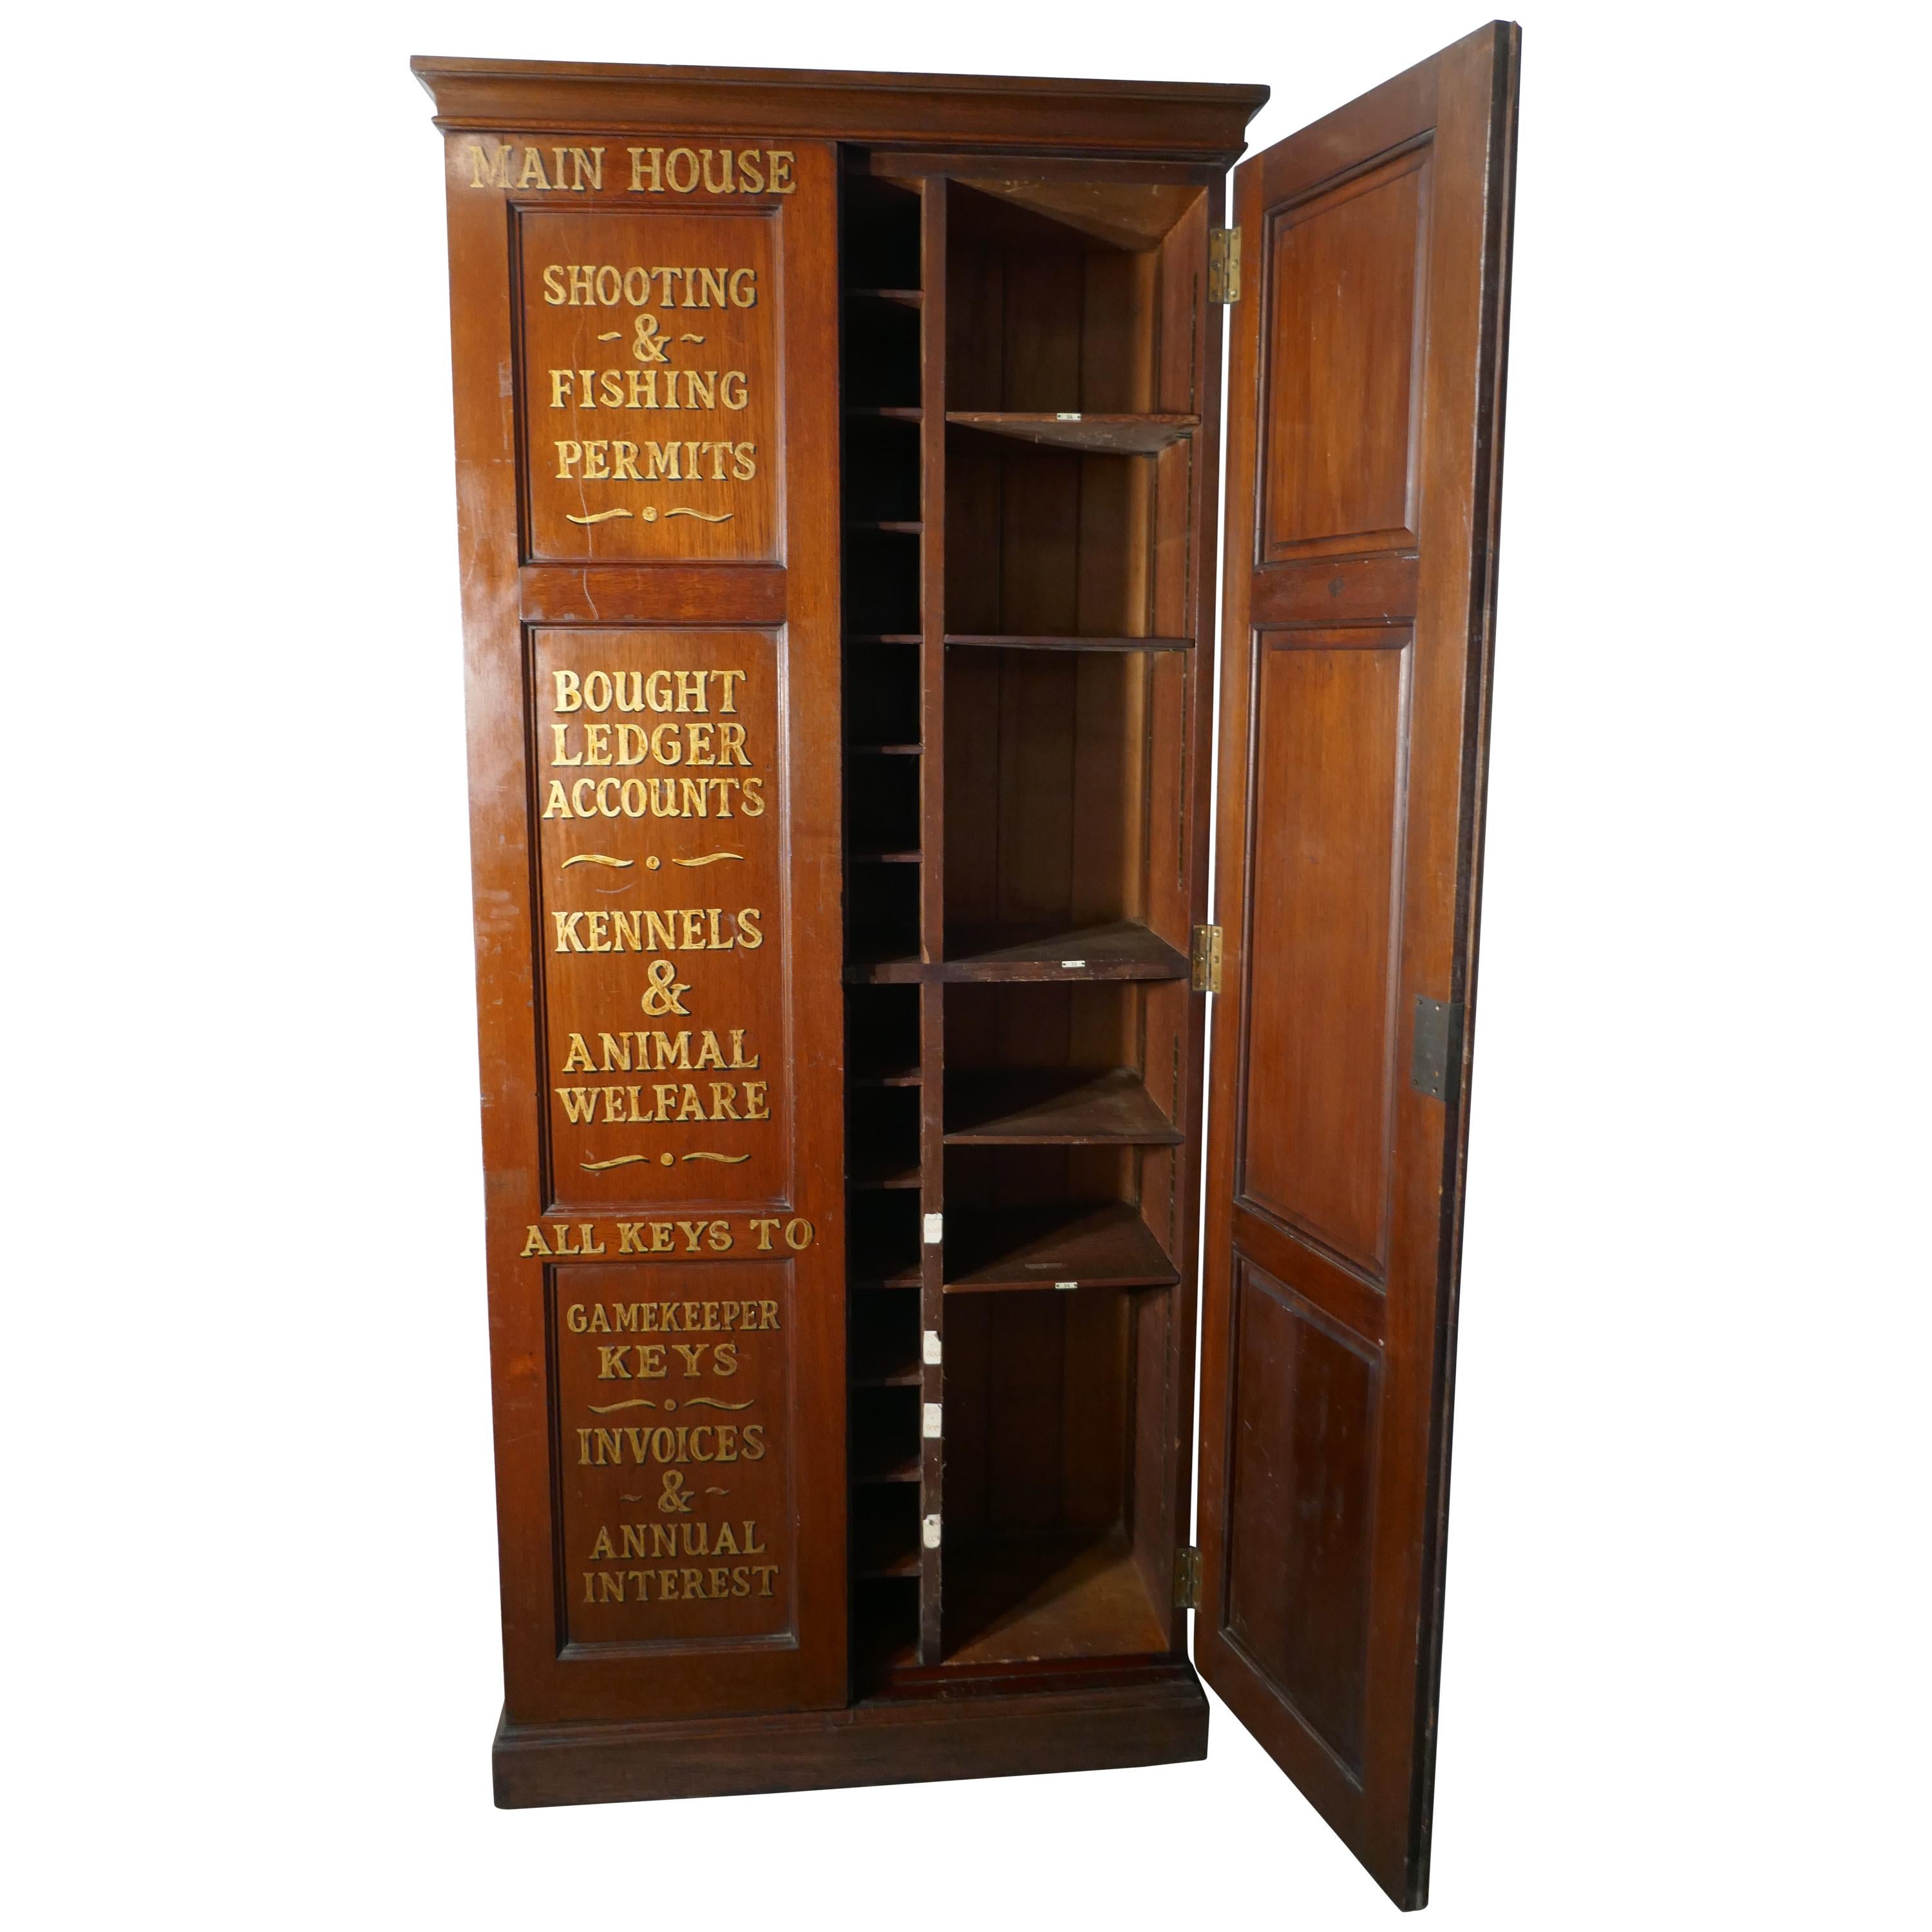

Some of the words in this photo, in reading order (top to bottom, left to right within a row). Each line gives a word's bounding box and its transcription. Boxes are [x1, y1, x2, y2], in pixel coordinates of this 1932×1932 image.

[468, 146, 607, 191] MAIN
[627, 147, 797, 194] HOUSE
[543, 265, 757, 308] SHOOTING
[632, 314, 671, 363] &
[548, 370, 748, 410] FISHING
[554, 440, 757, 480] PERMITS
[553, 670, 746, 713] BOUGHT
[551, 723, 753, 766] LEDGER
[542, 777, 765, 819] ACCOUNTS
[552, 908, 763, 952] KENNELS
[641, 960, 691, 1016] &
[562, 1029, 759, 1072] ANIMAL
[554, 1081, 770, 1124] WELFARE
[520, 1224, 605, 1256] ALL
[617, 1220, 734, 1253] KEYS
[750, 1218, 814, 1250] TO
[566, 1300, 781, 1333] GAMEKEEPER
[597, 1343, 738, 1379] KEYS
[576, 1425, 766, 1465] INVOICES
[658, 1470, 696, 1512] &
[589, 1520, 766, 1559] ANNUAL
[582, 1565, 779, 1603] INTEREST
